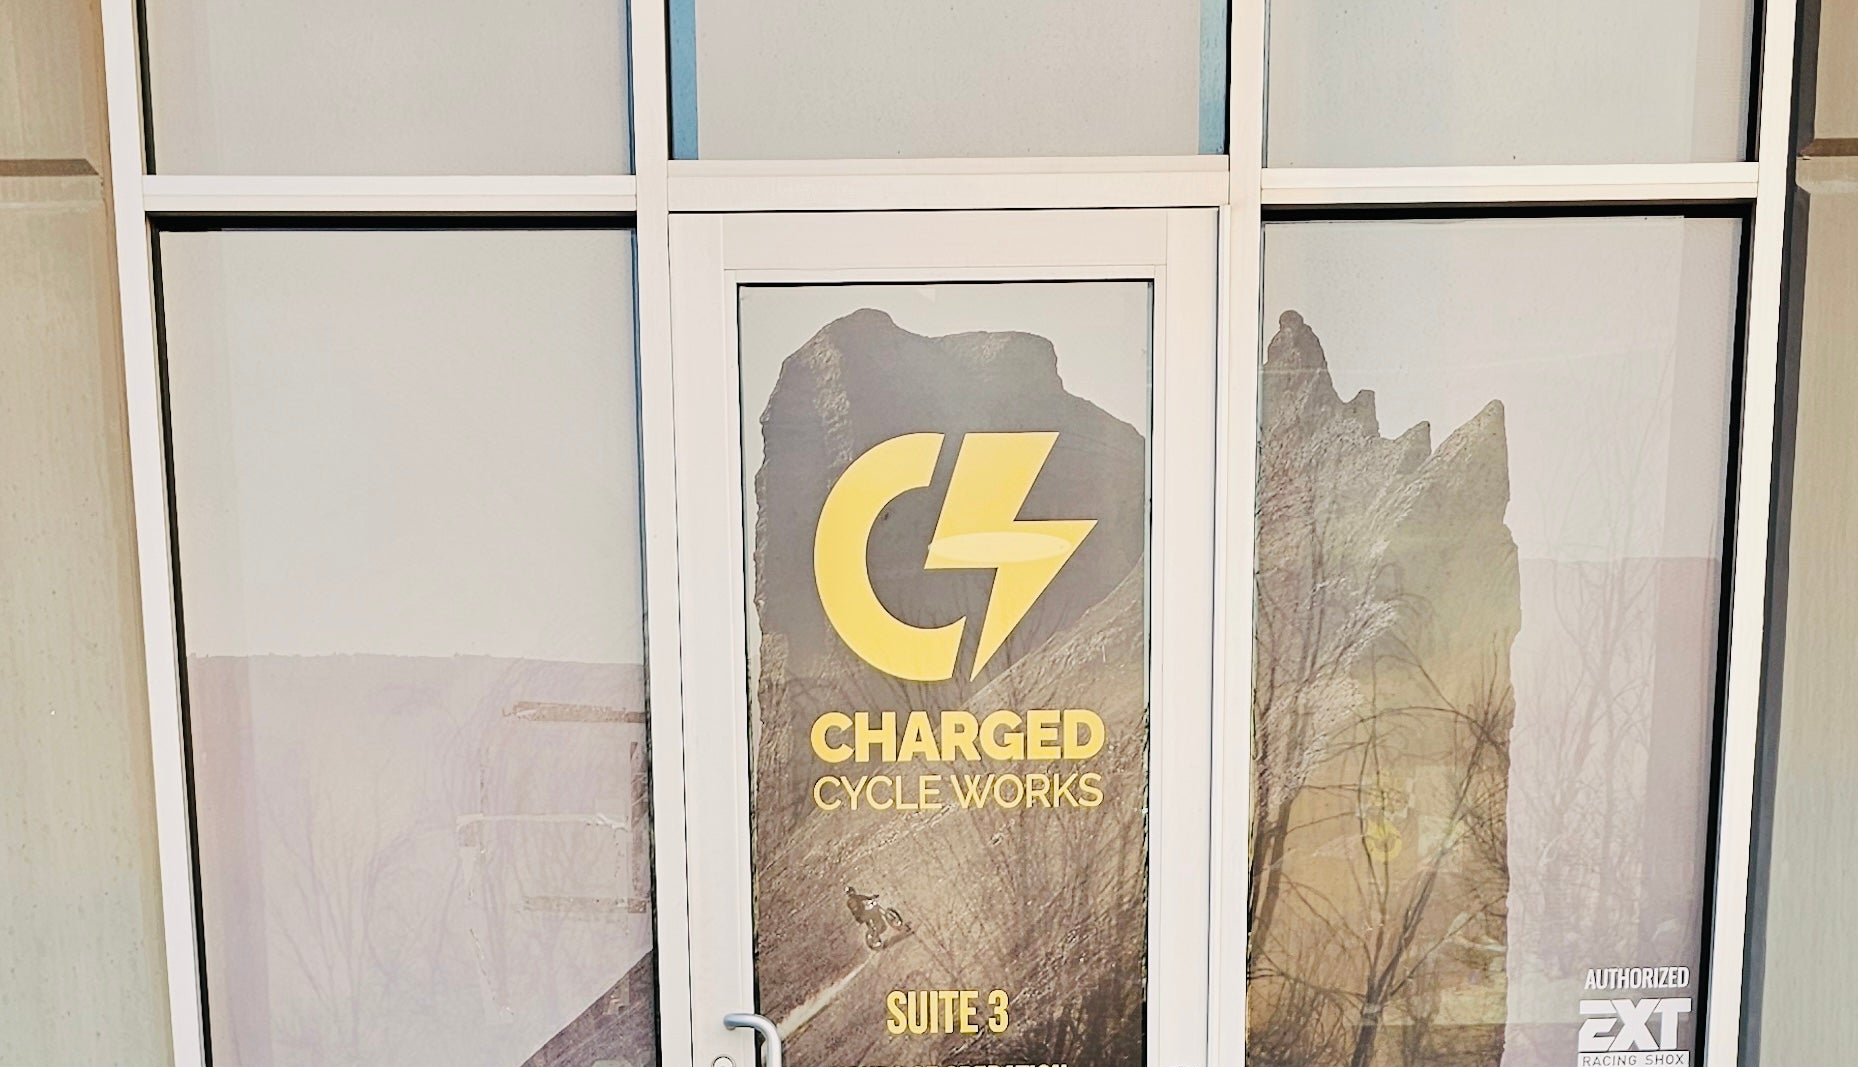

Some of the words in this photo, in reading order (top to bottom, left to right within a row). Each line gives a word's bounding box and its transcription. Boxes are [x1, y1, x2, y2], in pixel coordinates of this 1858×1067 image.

[810, 709, 1106, 763] CHARGED
[813, 774, 943, 811] CYCLE
[949, 772, 1104, 809] WORKS
[1584, 966, 1690, 990] AUTHORIZED
[886, 990, 979, 1035] SUITE
[988, 989, 1010, 1034] 3
[1578, 997, 1692, 1052] EXT
[1582, 1055, 1637, 1067] RACING
[1645, 1053, 1685, 1066] SHOX
